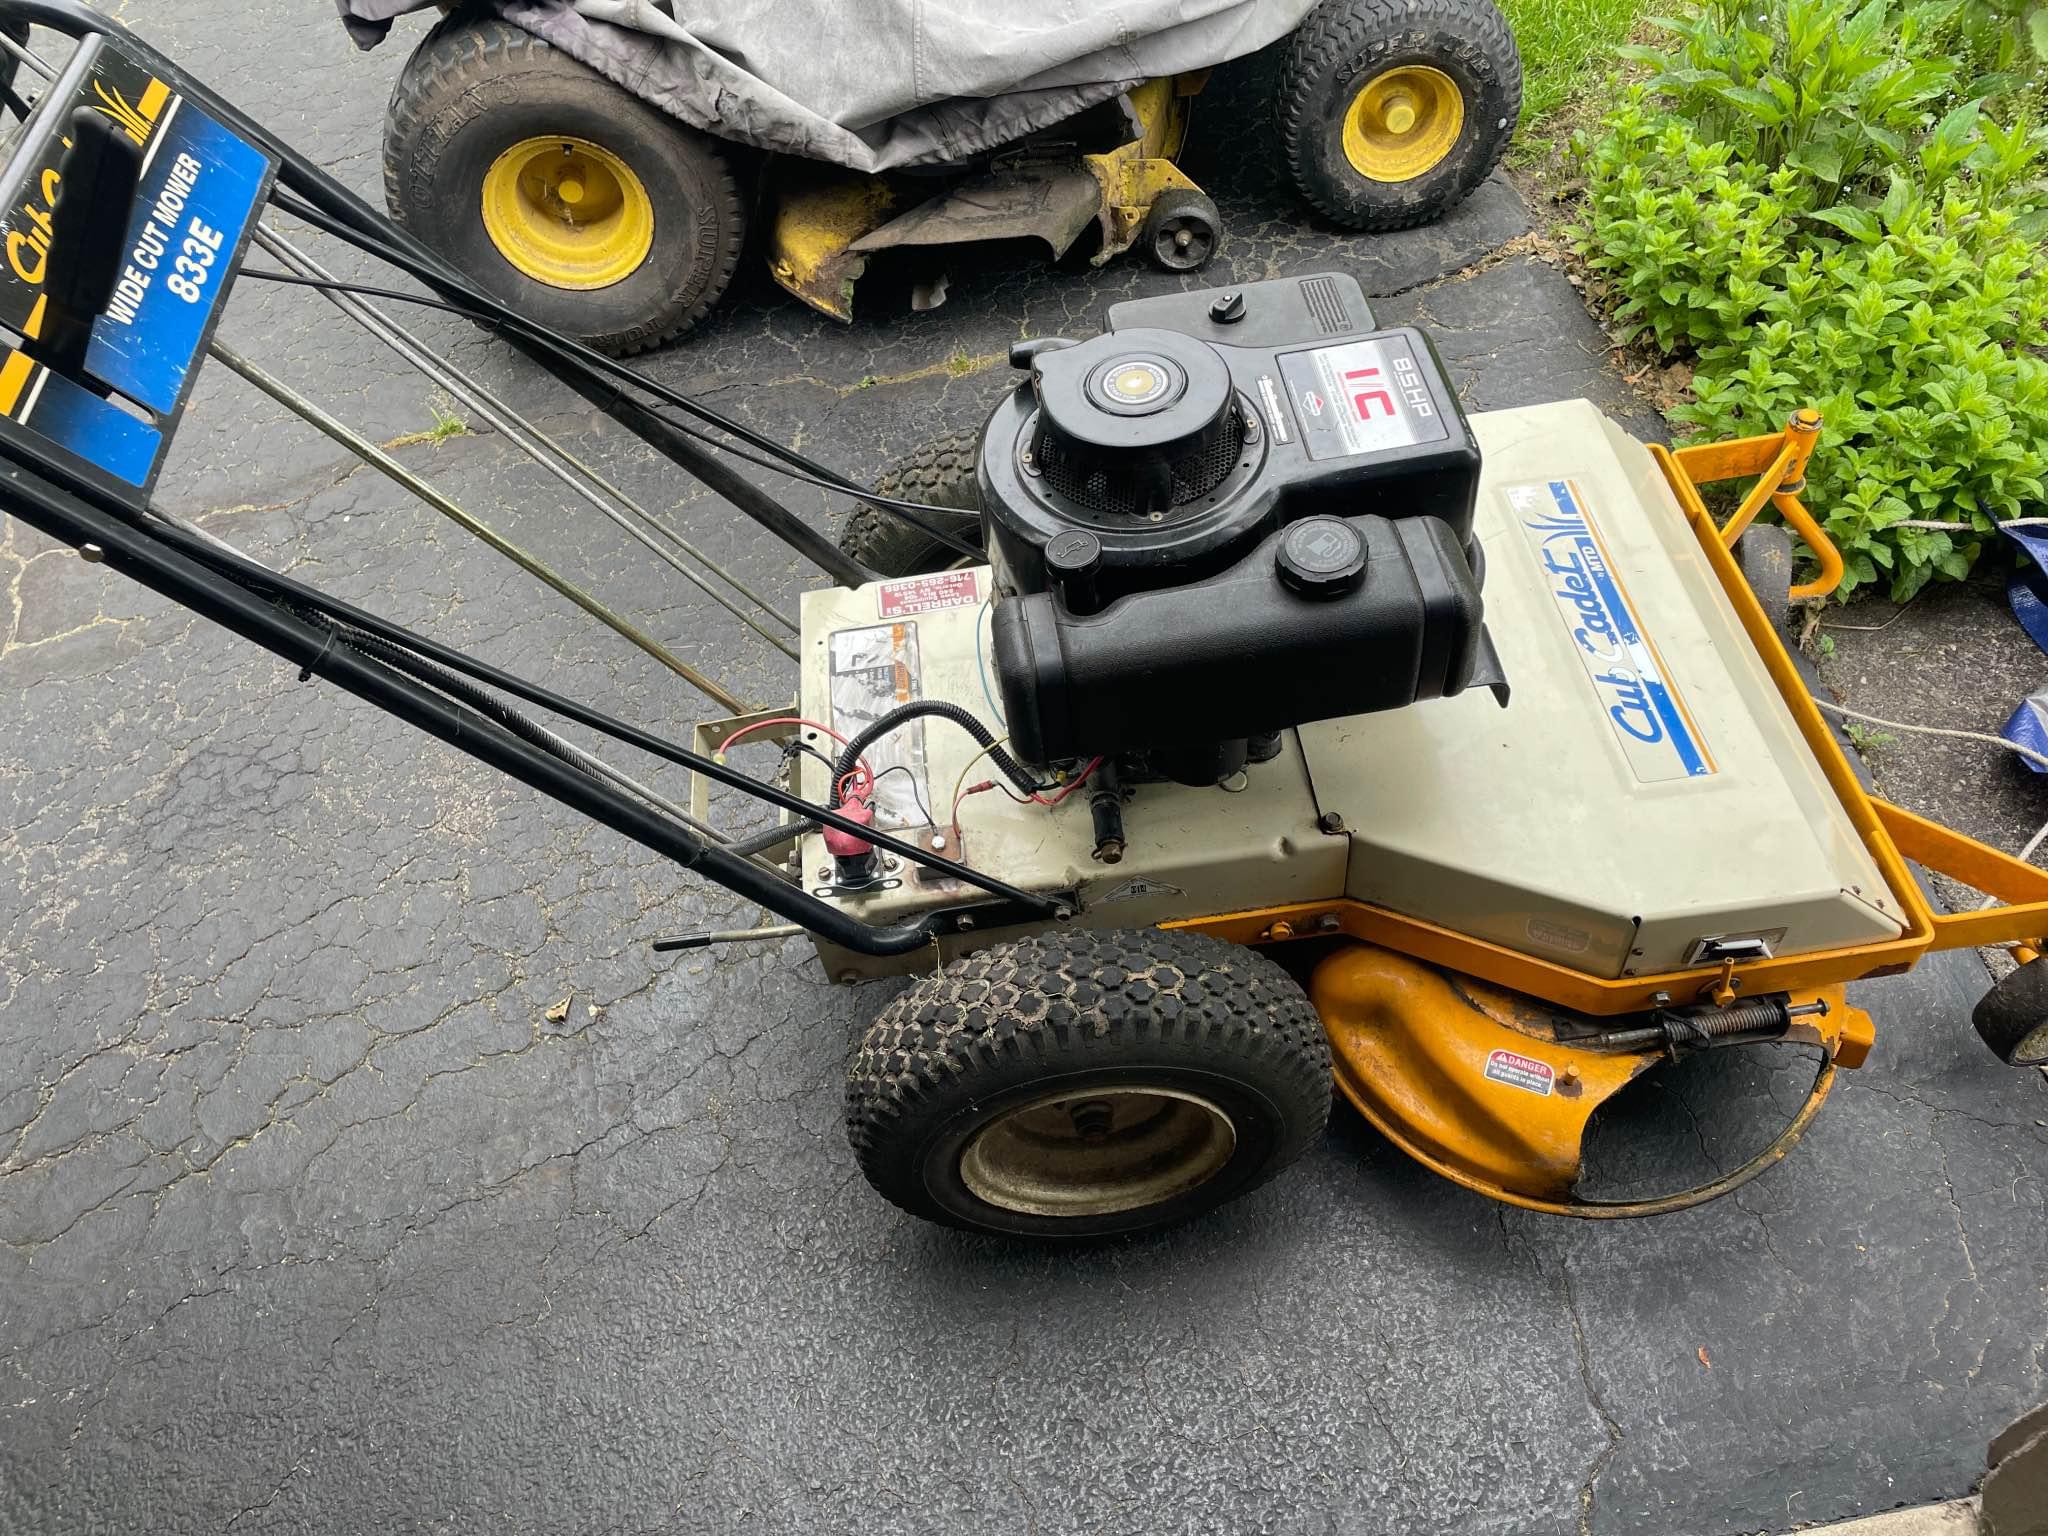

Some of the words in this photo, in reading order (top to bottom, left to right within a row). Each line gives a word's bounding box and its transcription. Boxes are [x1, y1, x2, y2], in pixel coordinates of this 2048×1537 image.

[1336, 30, 1425, 84] SUPER
[106, 265, 151, 326] WIDE
[133, 221, 169, 270] CUT
[152, 153, 201, 228] MOWER
[167, 217, 224, 304] 833E
[671, 205, 719, 308] SUPER
[1582, 546, 1604, 572] MTD
[893, 595, 974, 614] DARRELL'S
[1542, 548, 1625, 663] Cadet
[1595, 668, 1663, 744] Cub
[1508, 1055, 1547, 1075] DANGER
[1529, 1072, 1550, 1083] without
